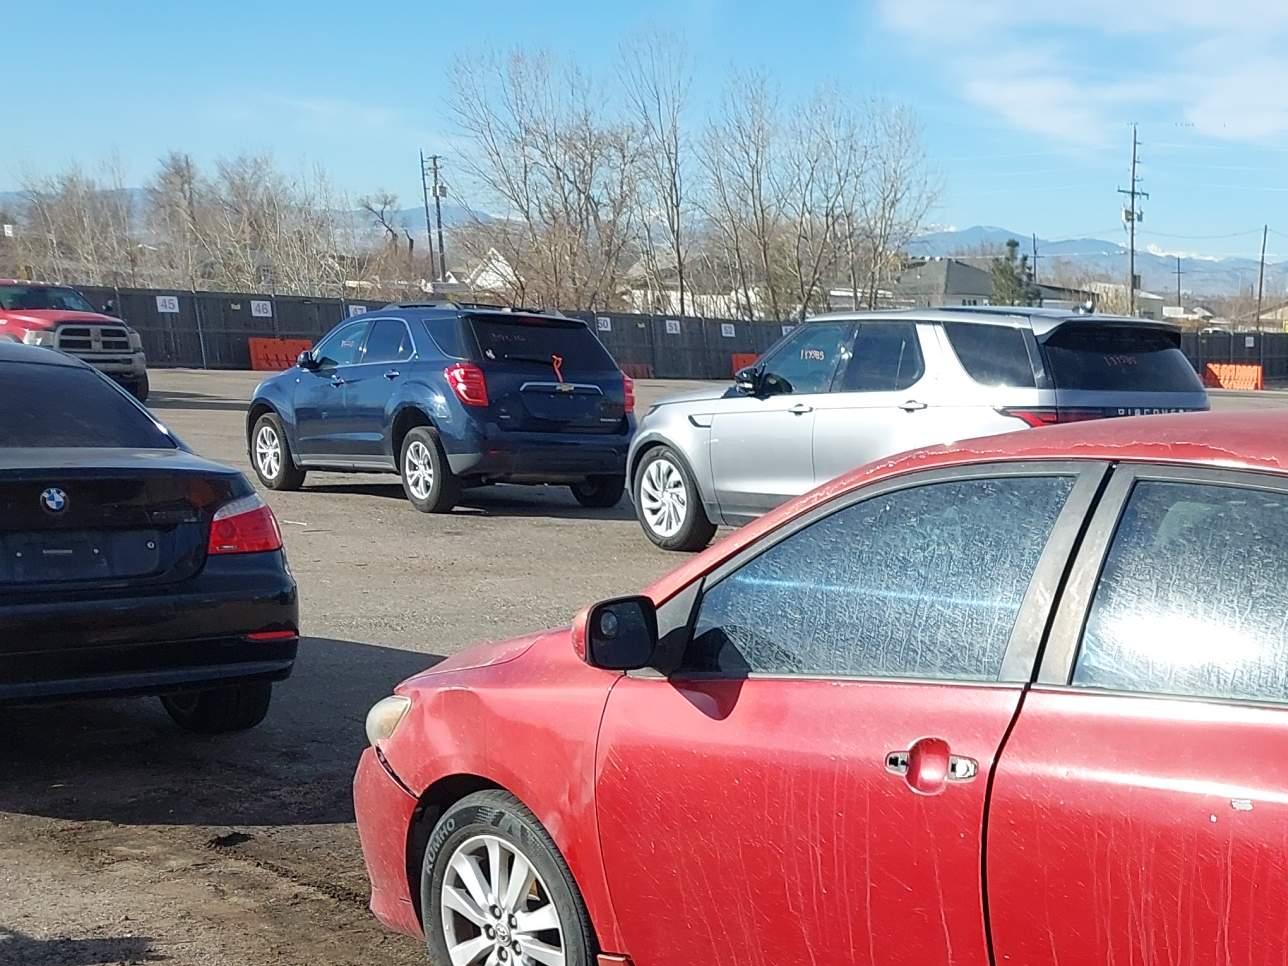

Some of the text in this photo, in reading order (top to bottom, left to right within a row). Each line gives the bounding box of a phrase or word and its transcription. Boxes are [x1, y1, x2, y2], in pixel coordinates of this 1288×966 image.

[160, 299, 176, 311] 45
[254, 304, 270, 315] 46
[668, 321, 680, 331] 51
[426, 818, 455, 875] KUMHO
